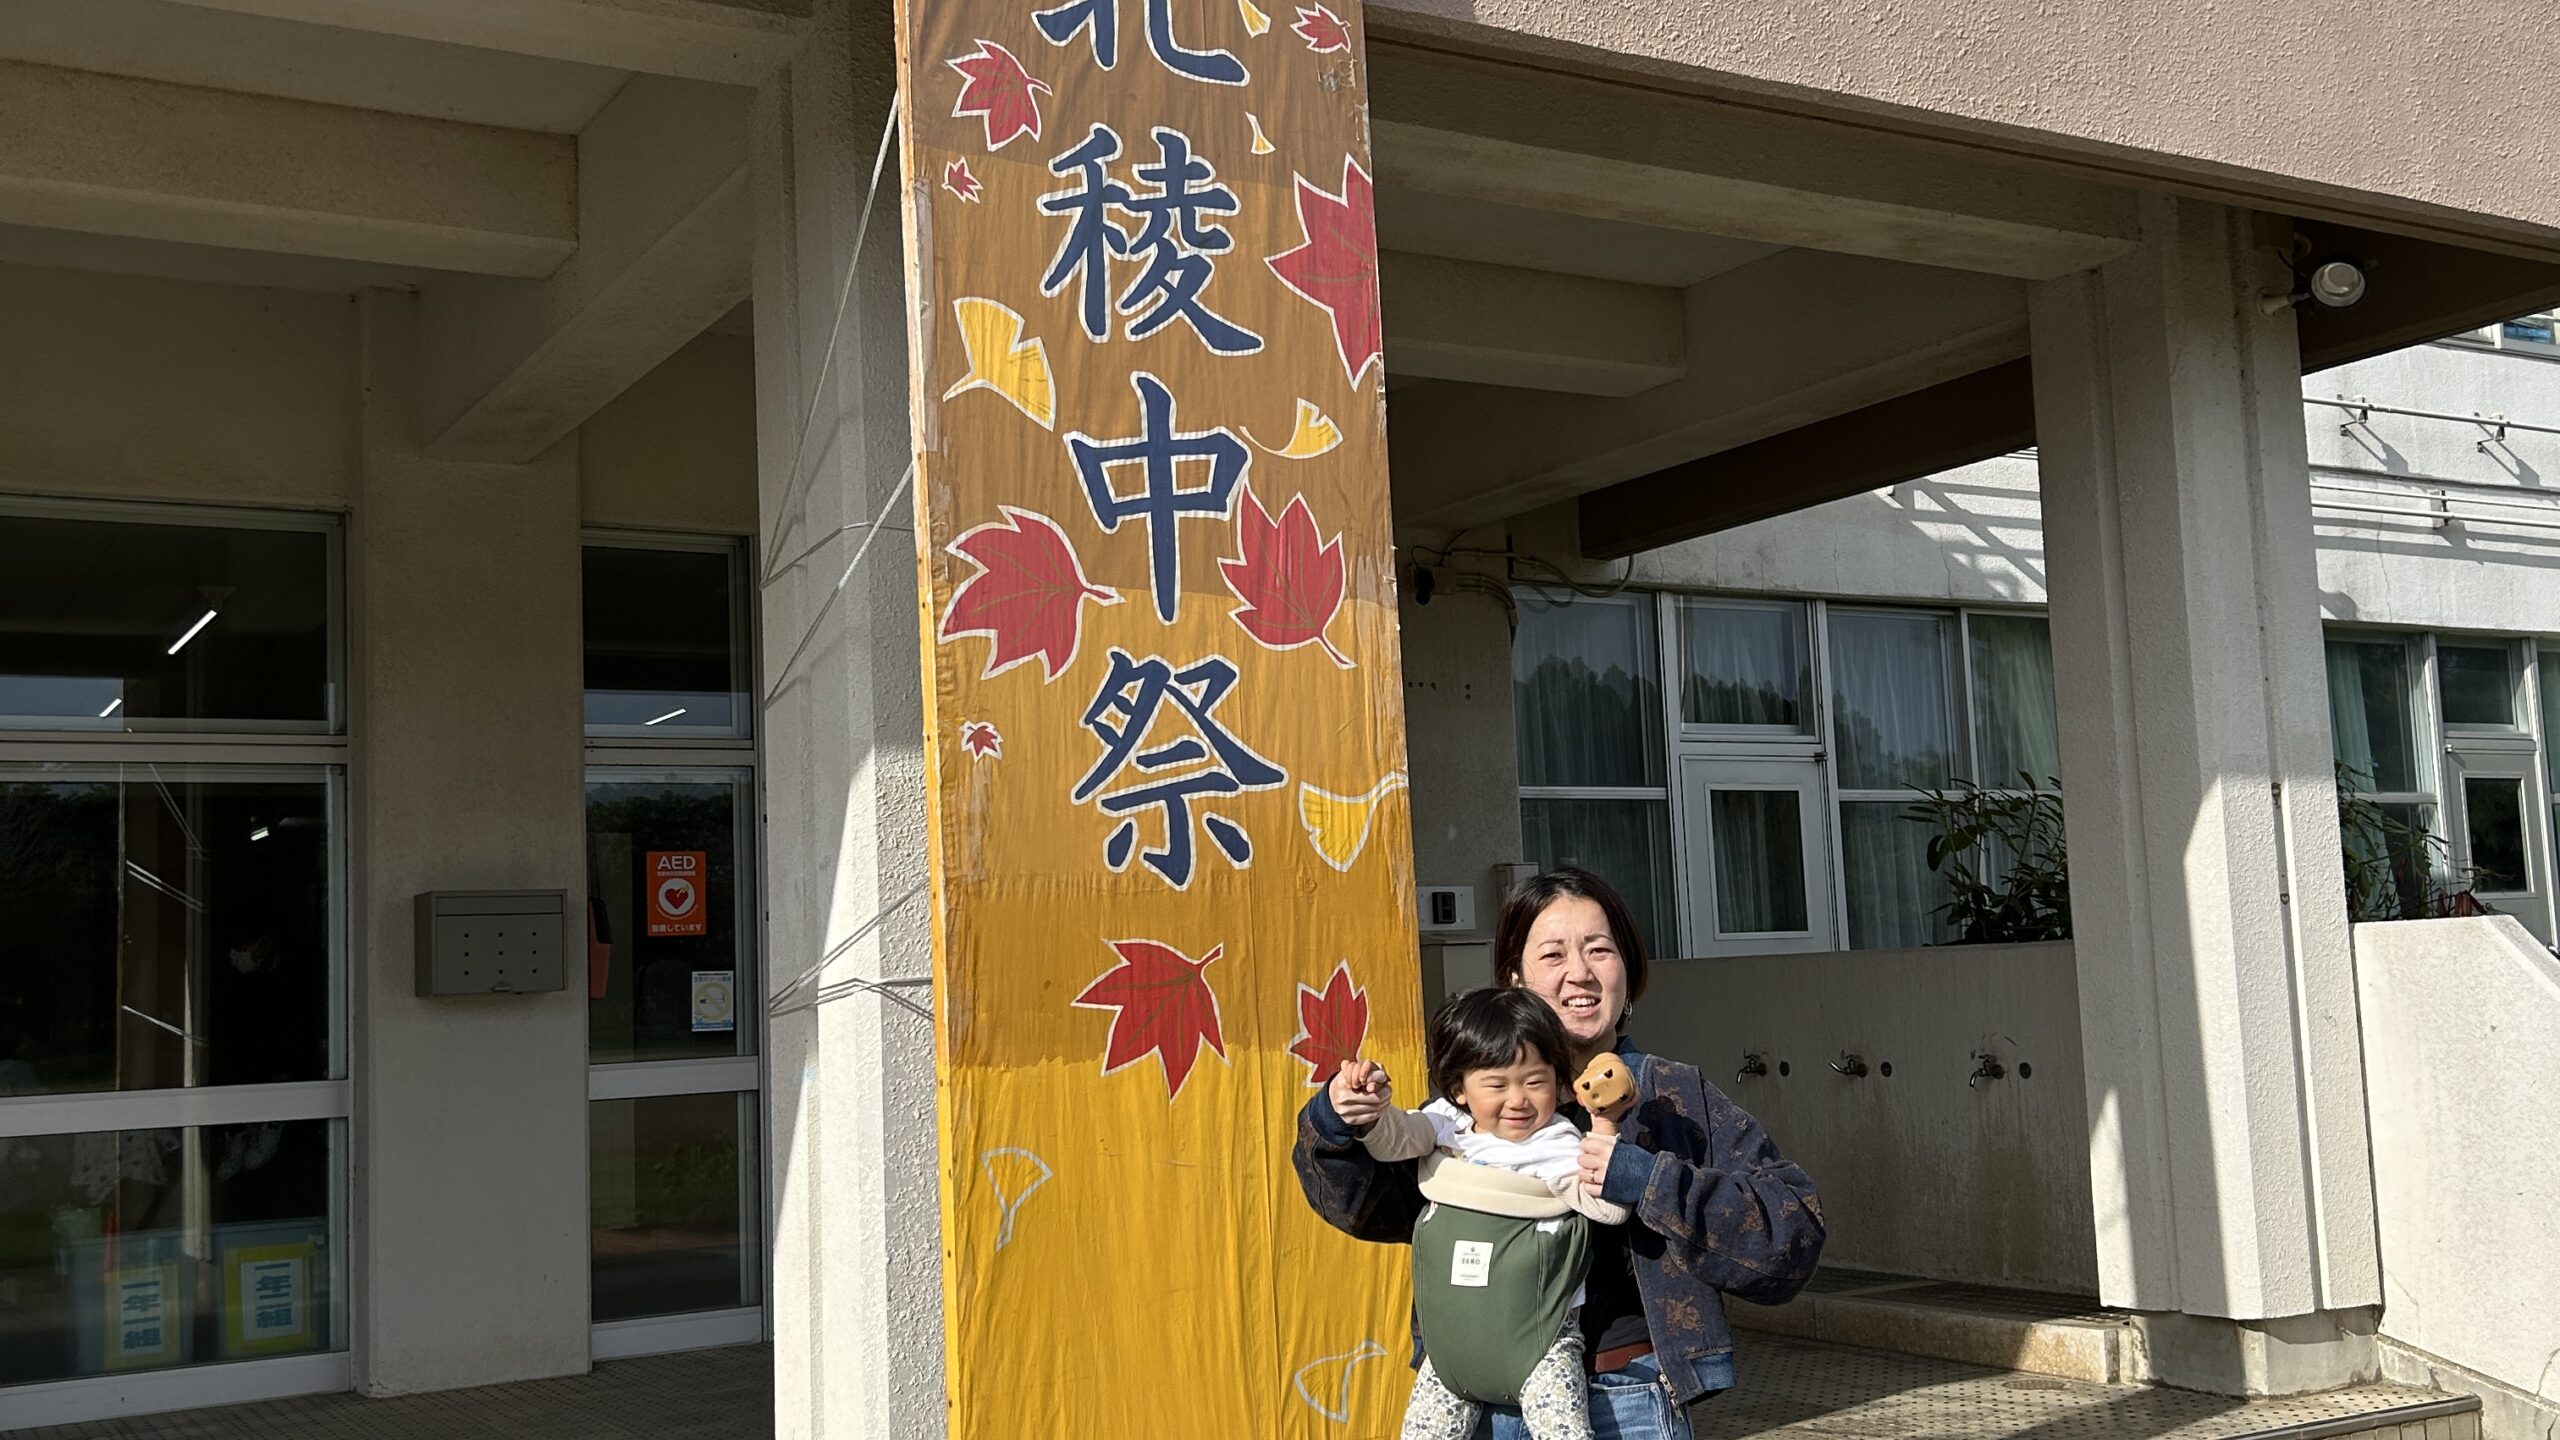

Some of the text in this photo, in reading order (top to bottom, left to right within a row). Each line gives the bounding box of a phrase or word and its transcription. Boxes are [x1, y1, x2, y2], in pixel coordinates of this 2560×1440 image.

[657, 855, 696, 870] AED
[122, 1280, 161, 1349] 一年一組
[254, 1262, 293, 1328] 一年二組
